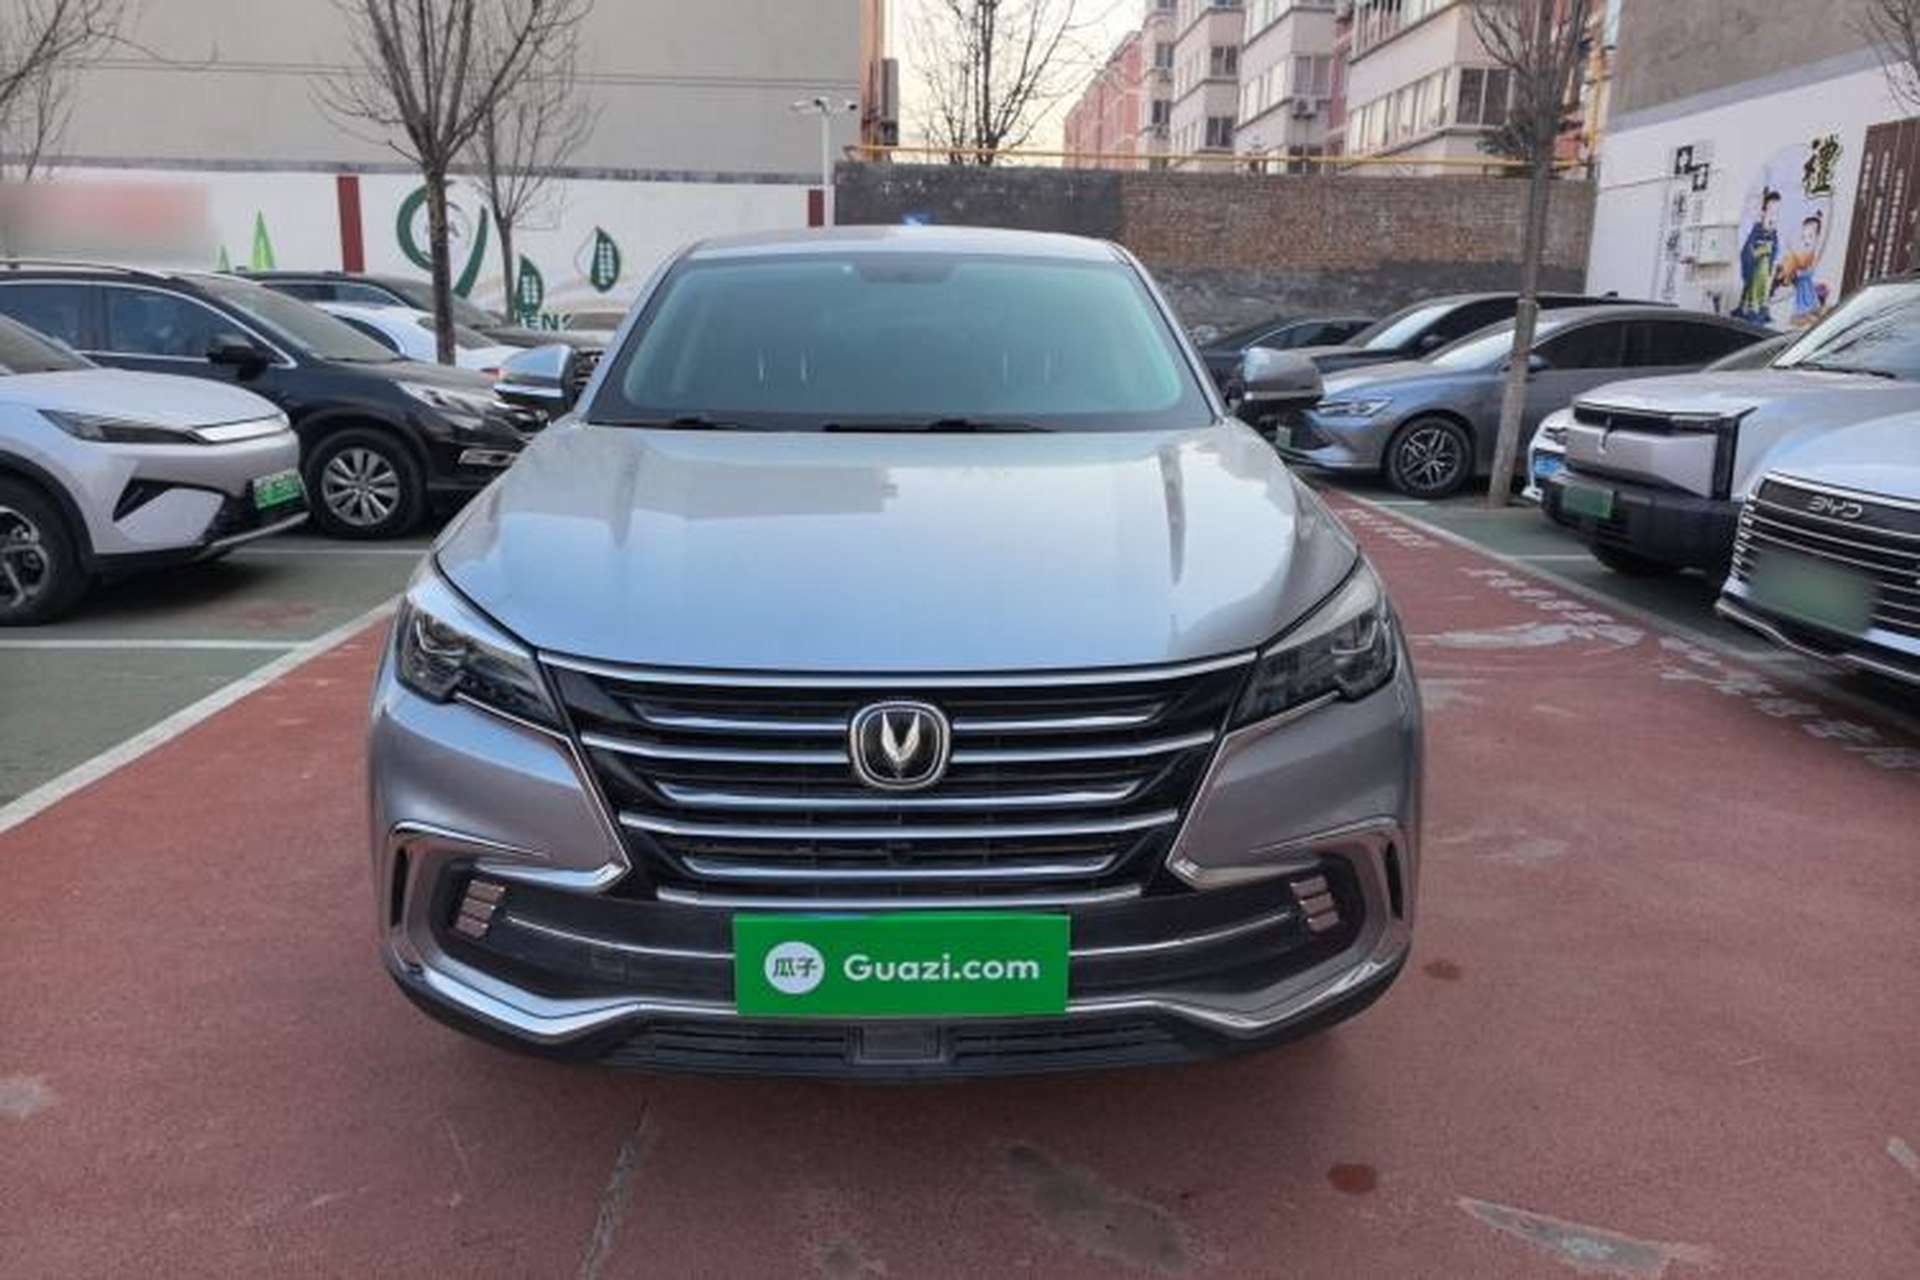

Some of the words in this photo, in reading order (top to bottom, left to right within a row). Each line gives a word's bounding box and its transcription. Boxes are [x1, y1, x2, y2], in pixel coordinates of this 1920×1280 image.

[1808, 495, 1863, 519] BYD
[772, 956, 818, 978] 瓜子
[843, 953, 1040, 982] Guazi.com
